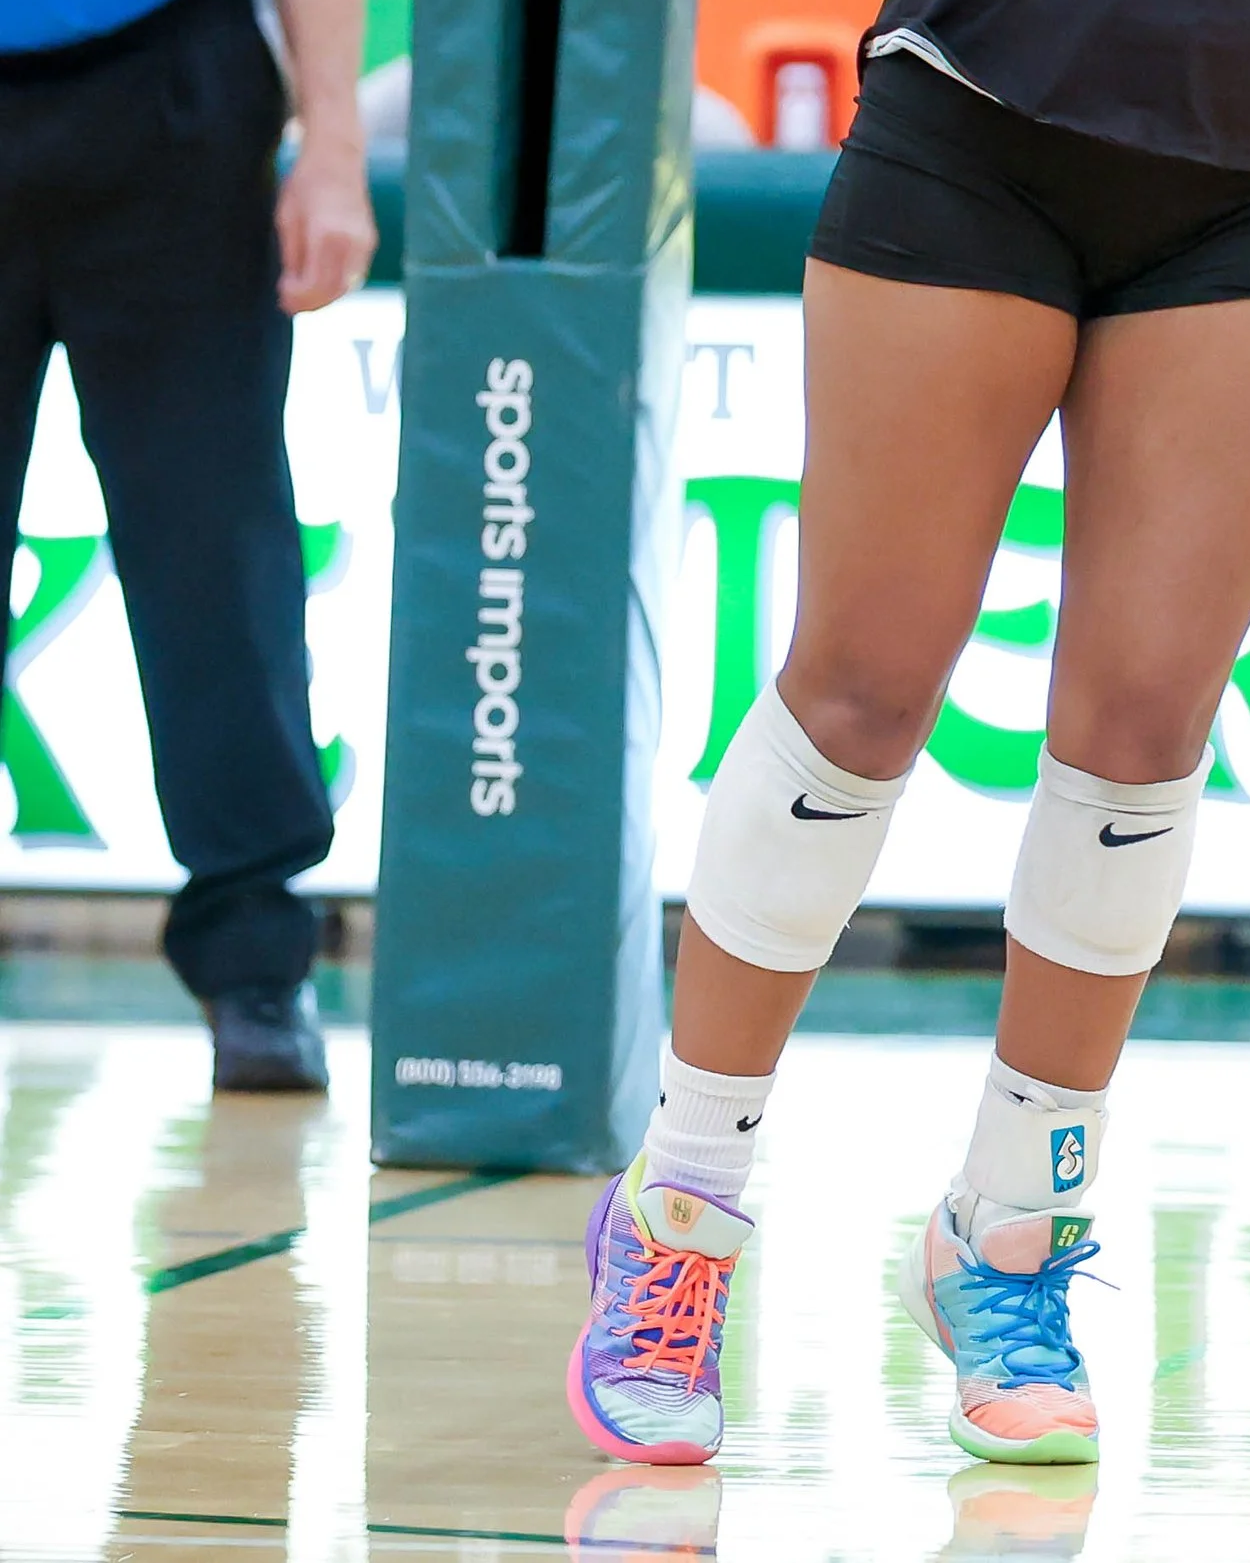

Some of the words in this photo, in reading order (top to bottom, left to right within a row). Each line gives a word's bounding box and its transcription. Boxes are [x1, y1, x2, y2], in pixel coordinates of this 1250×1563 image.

[476, 357, 535, 561] sports
[466, 567, 523, 817] imports
[395, 1057, 457, 1088] (800)
